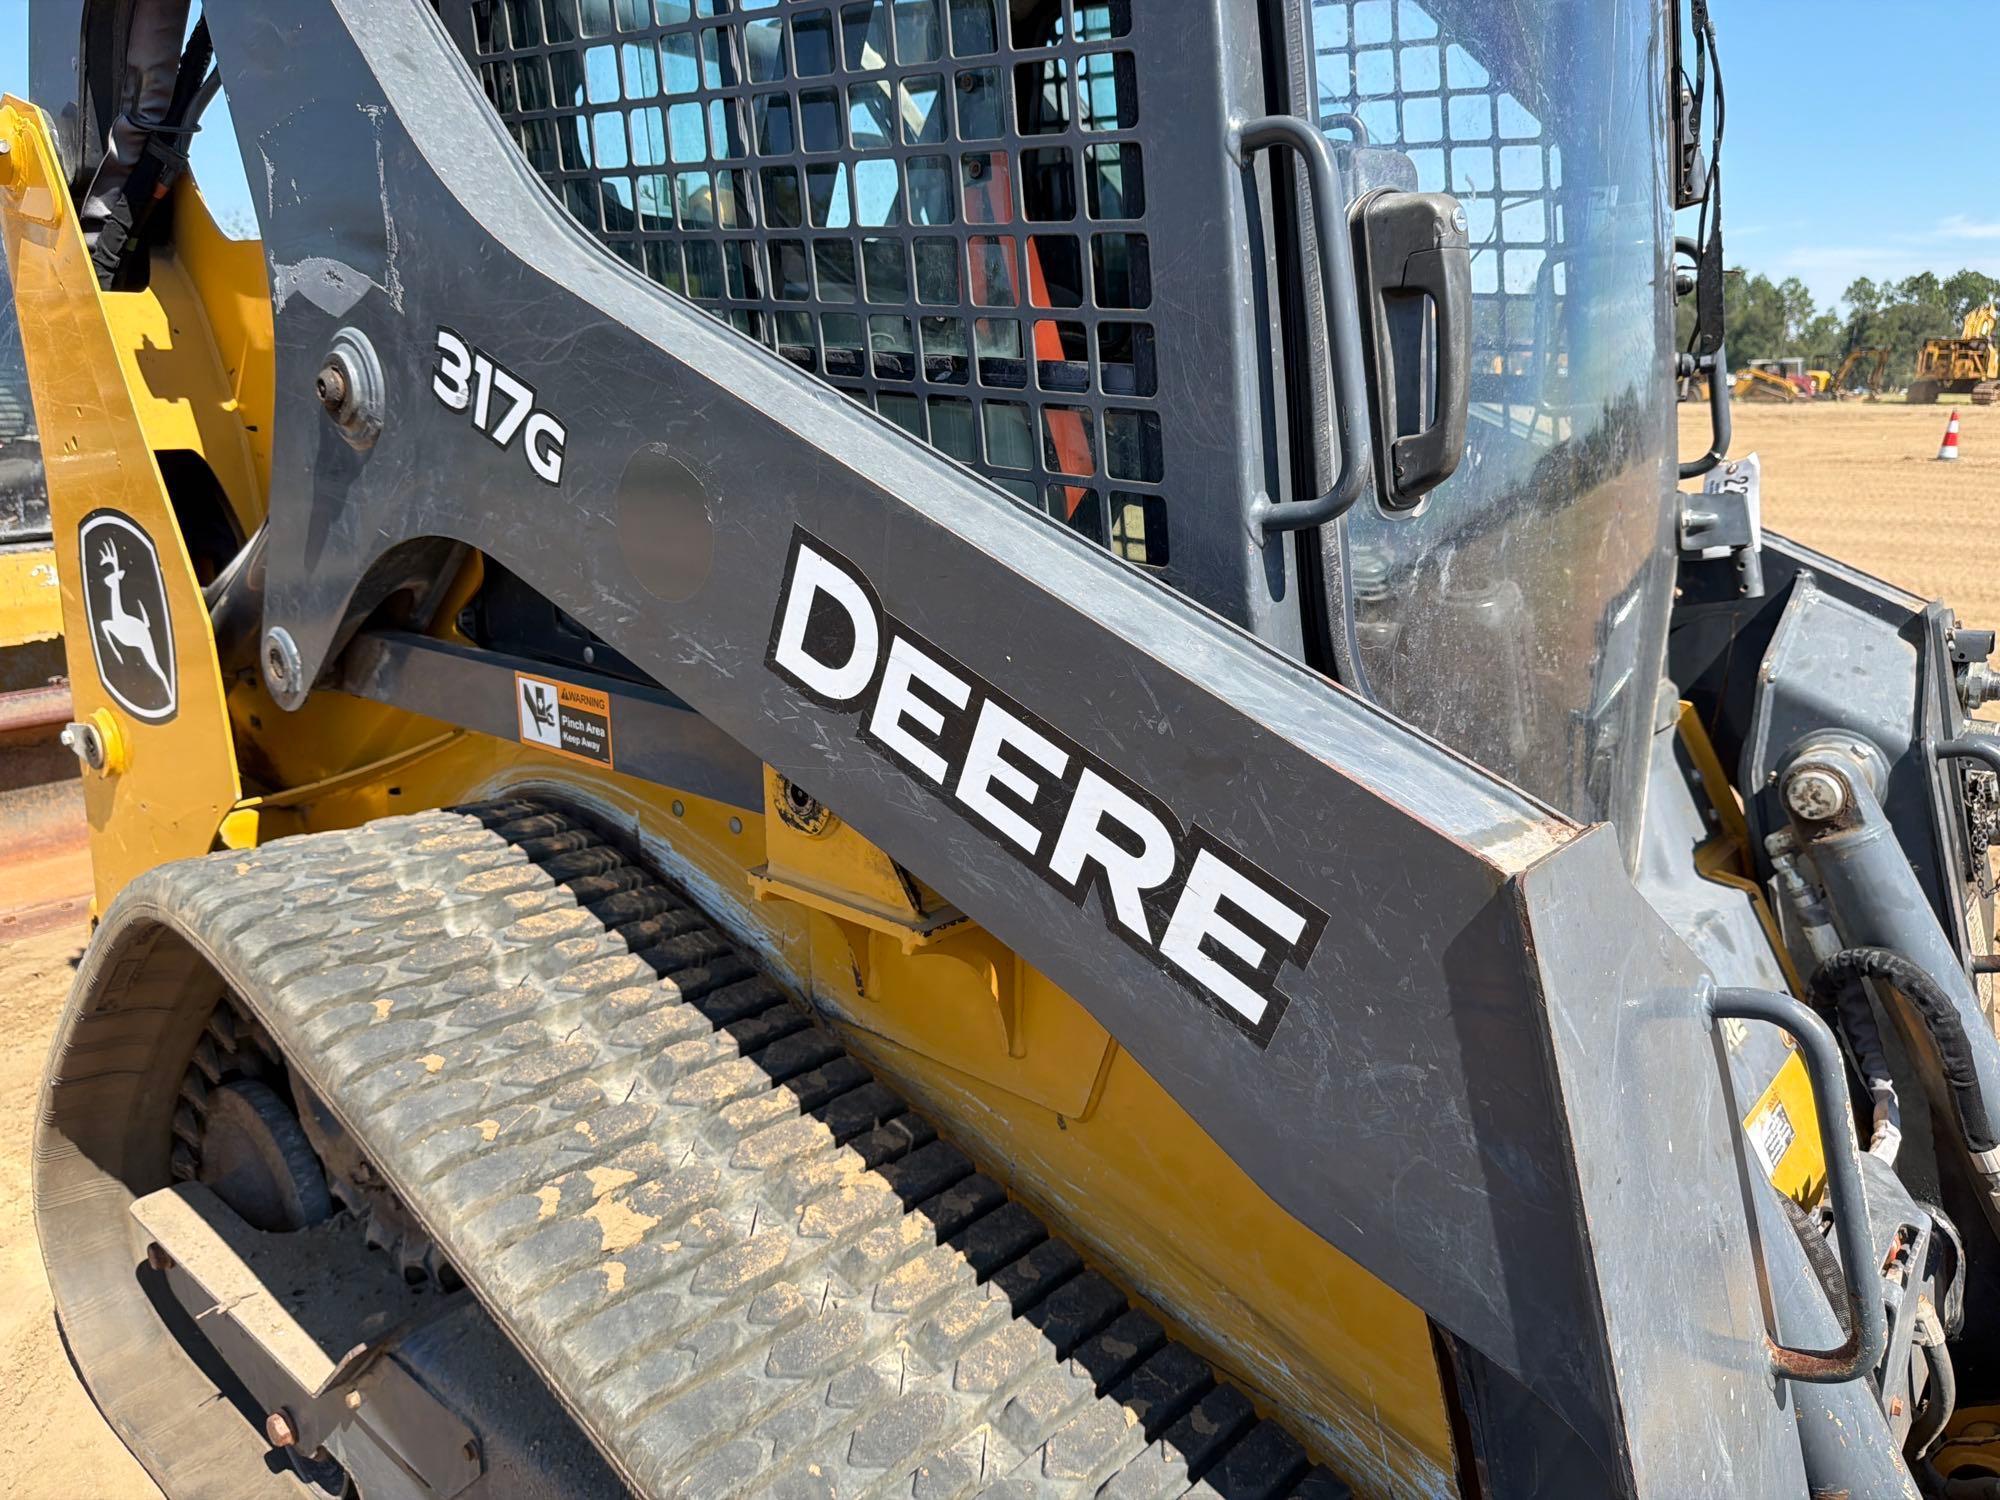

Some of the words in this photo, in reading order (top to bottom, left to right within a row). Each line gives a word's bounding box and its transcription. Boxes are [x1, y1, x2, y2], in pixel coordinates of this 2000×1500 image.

[432, 330, 566, 484] 317G
[568, 690, 605, 710] WARNING
[561, 715, 584, 731] Pinch
[586, 722, 605, 737] Area
[563, 731, 580, 746] Keep
[581, 737, 600, 752] Away
[775, 543, 1307, 1026] DEERE
